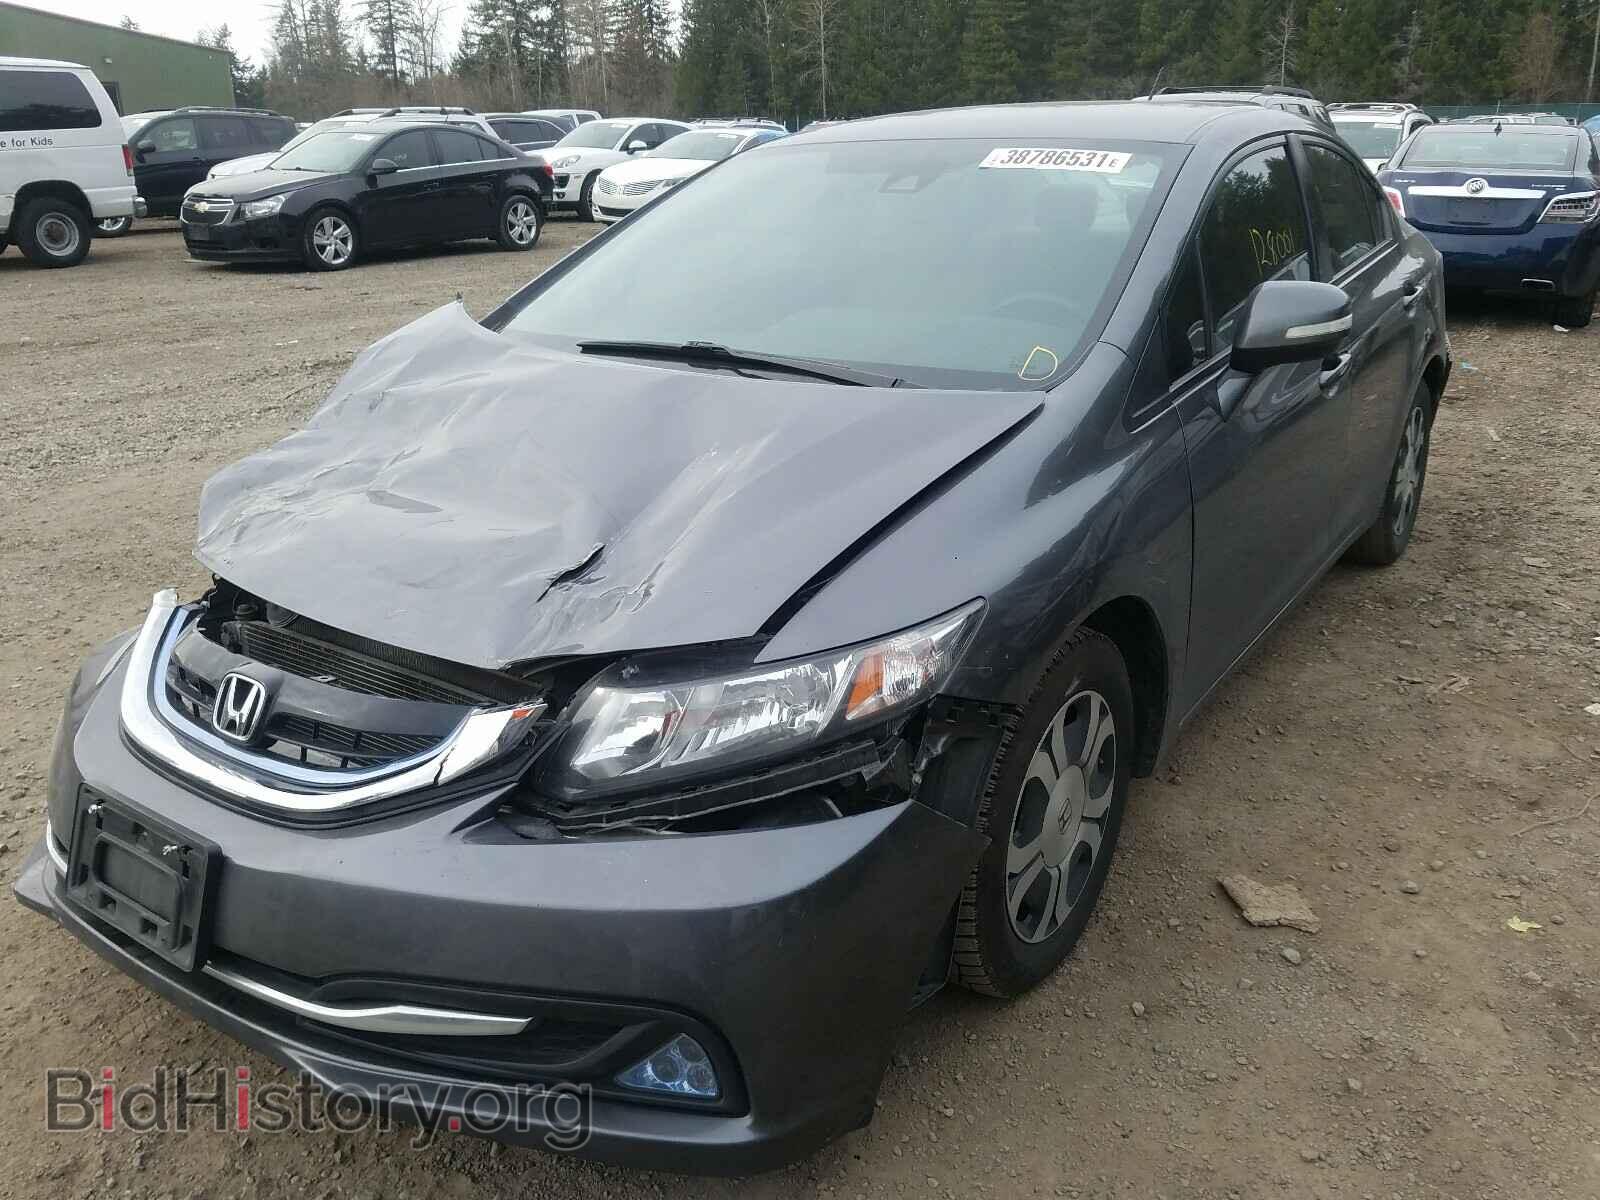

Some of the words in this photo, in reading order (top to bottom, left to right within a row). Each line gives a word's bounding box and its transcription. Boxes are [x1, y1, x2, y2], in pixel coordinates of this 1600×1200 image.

[11, 138, 26, 147] for
[30, 136, 54, 146] Kids
[1000, 149, 1109, 168] 38786531
